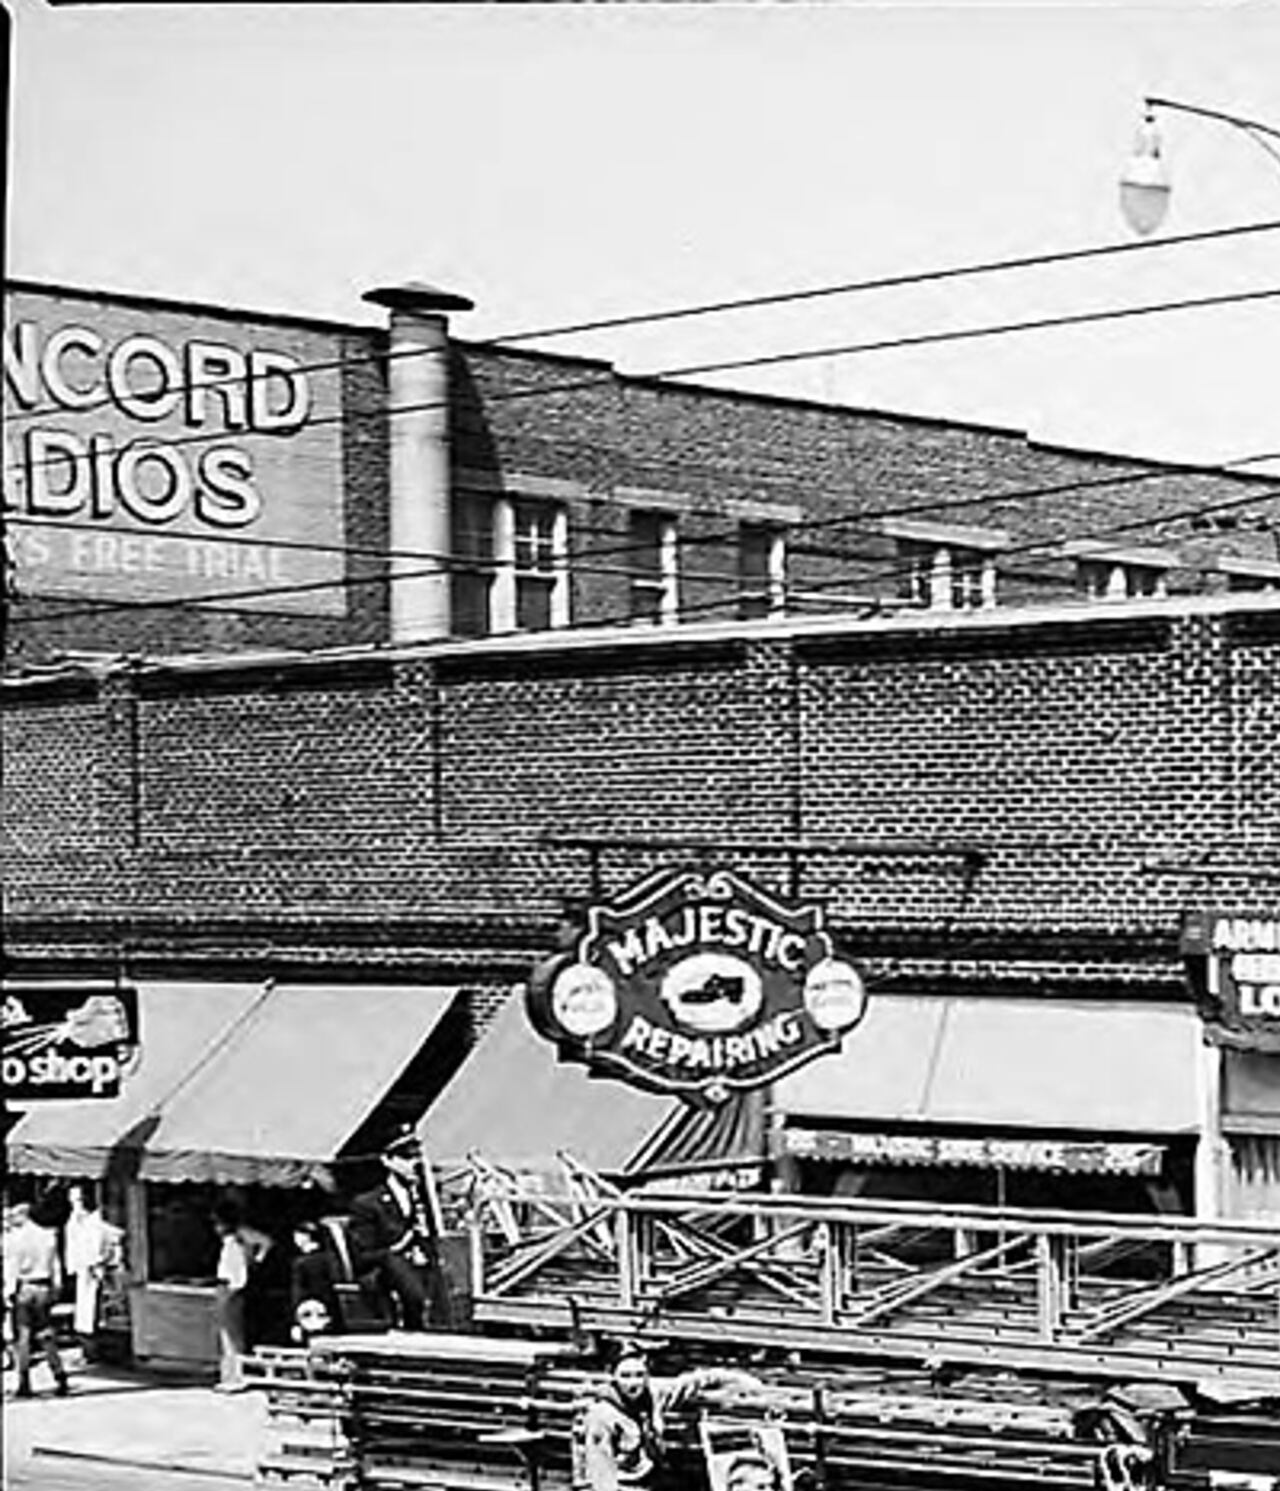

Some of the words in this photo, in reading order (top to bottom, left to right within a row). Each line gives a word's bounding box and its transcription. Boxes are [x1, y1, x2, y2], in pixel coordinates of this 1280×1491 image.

[72, 533, 162, 573] FREE
[187, 541, 283, 581] TRIAL
[607, 905, 806, 974] MAJESTIC
[621, 1007, 804, 1070] REPAIRING
[28, 1047, 120, 1093] shop
